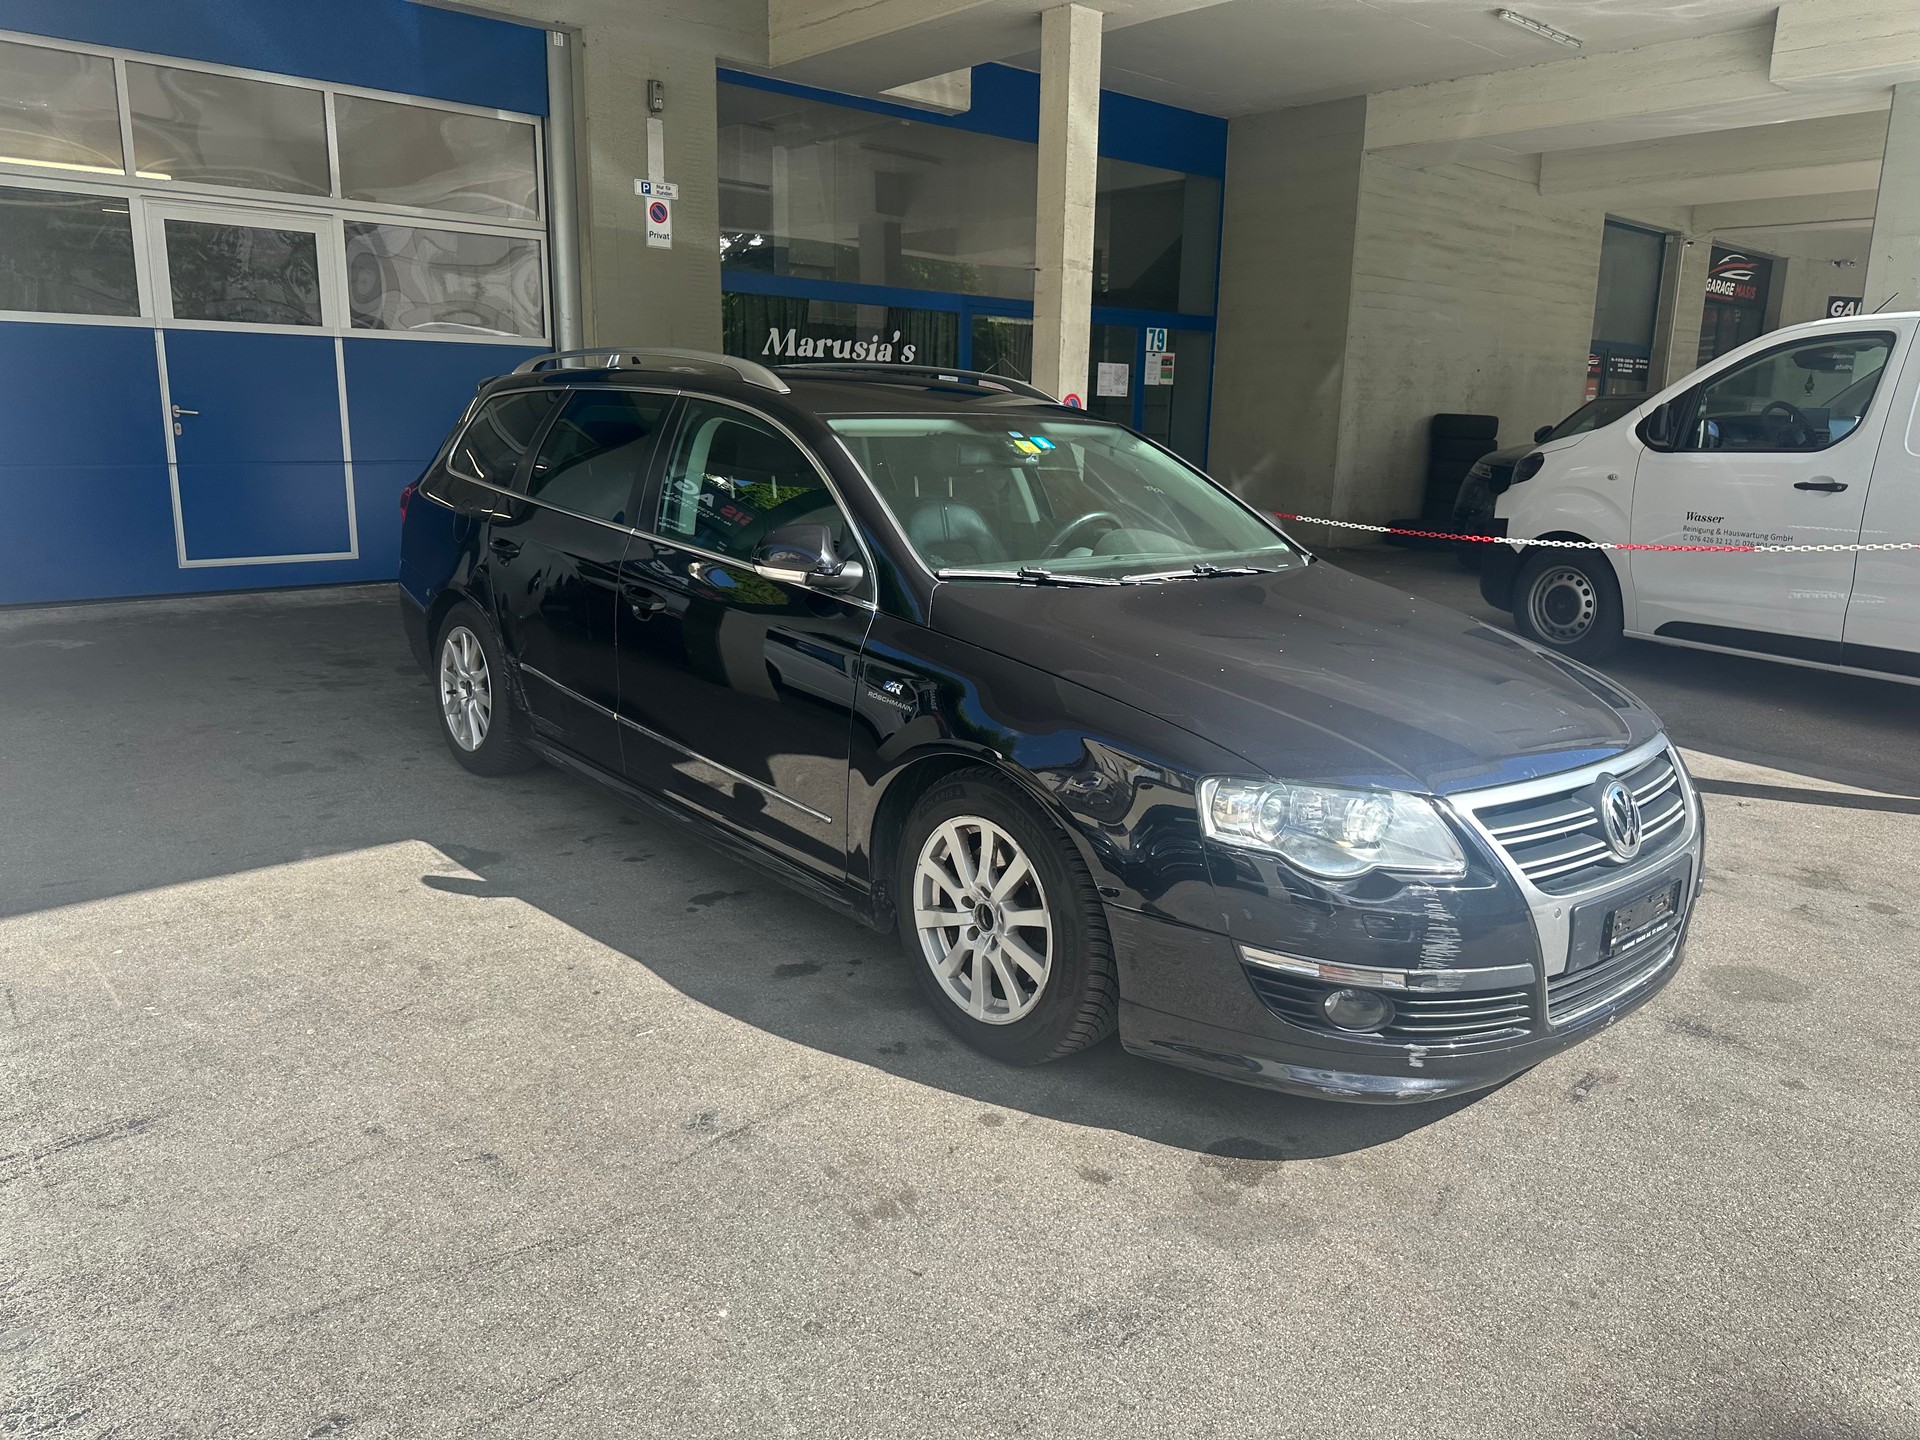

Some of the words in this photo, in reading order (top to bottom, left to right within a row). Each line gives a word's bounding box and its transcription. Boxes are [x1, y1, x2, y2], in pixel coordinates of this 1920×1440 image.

[643, 183, 650, 193] P
[649, 230, 670, 240] Privat
[1705, 277, 1735, 296] GARAGE
[761, 327, 917, 364] Marusia's
[1148, 328, 1165, 351] 79
[1685, 511, 1725, 524] Wasser
[1682, 524, 1715, 536] Reinigung
[1723, 529, 1769, 541] Hauswartung
[1770, 533, 1794, 542] GmbH
[867, 691, 913, 712] RÖSCHMANN
